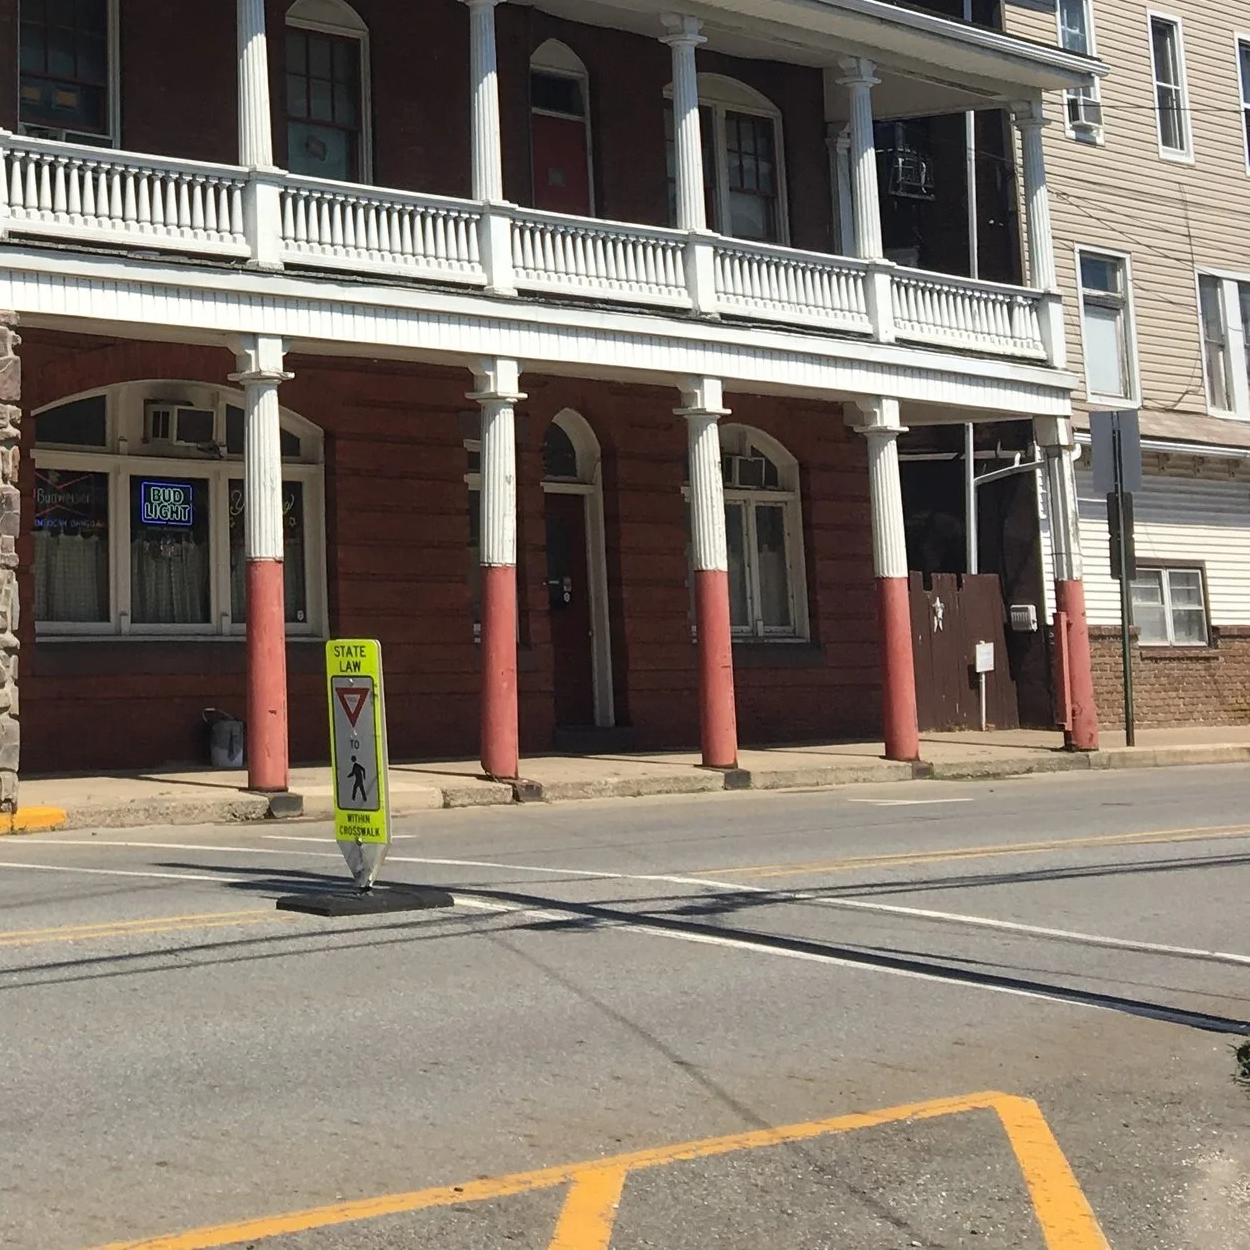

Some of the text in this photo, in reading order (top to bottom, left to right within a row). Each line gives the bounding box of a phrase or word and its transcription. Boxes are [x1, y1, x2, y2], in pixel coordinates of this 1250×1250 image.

[150, 486, 184, 504] BUD
[144, 502, 191, 521] LIGHT
[333, 645, 366, 658] STATE
[339, 661, 361, 672] LAW
[350, 739, 360, 750] TO
[346, 813, 370, 824] WITHIN
[339, 824, 380, 837] CROSSWALK
